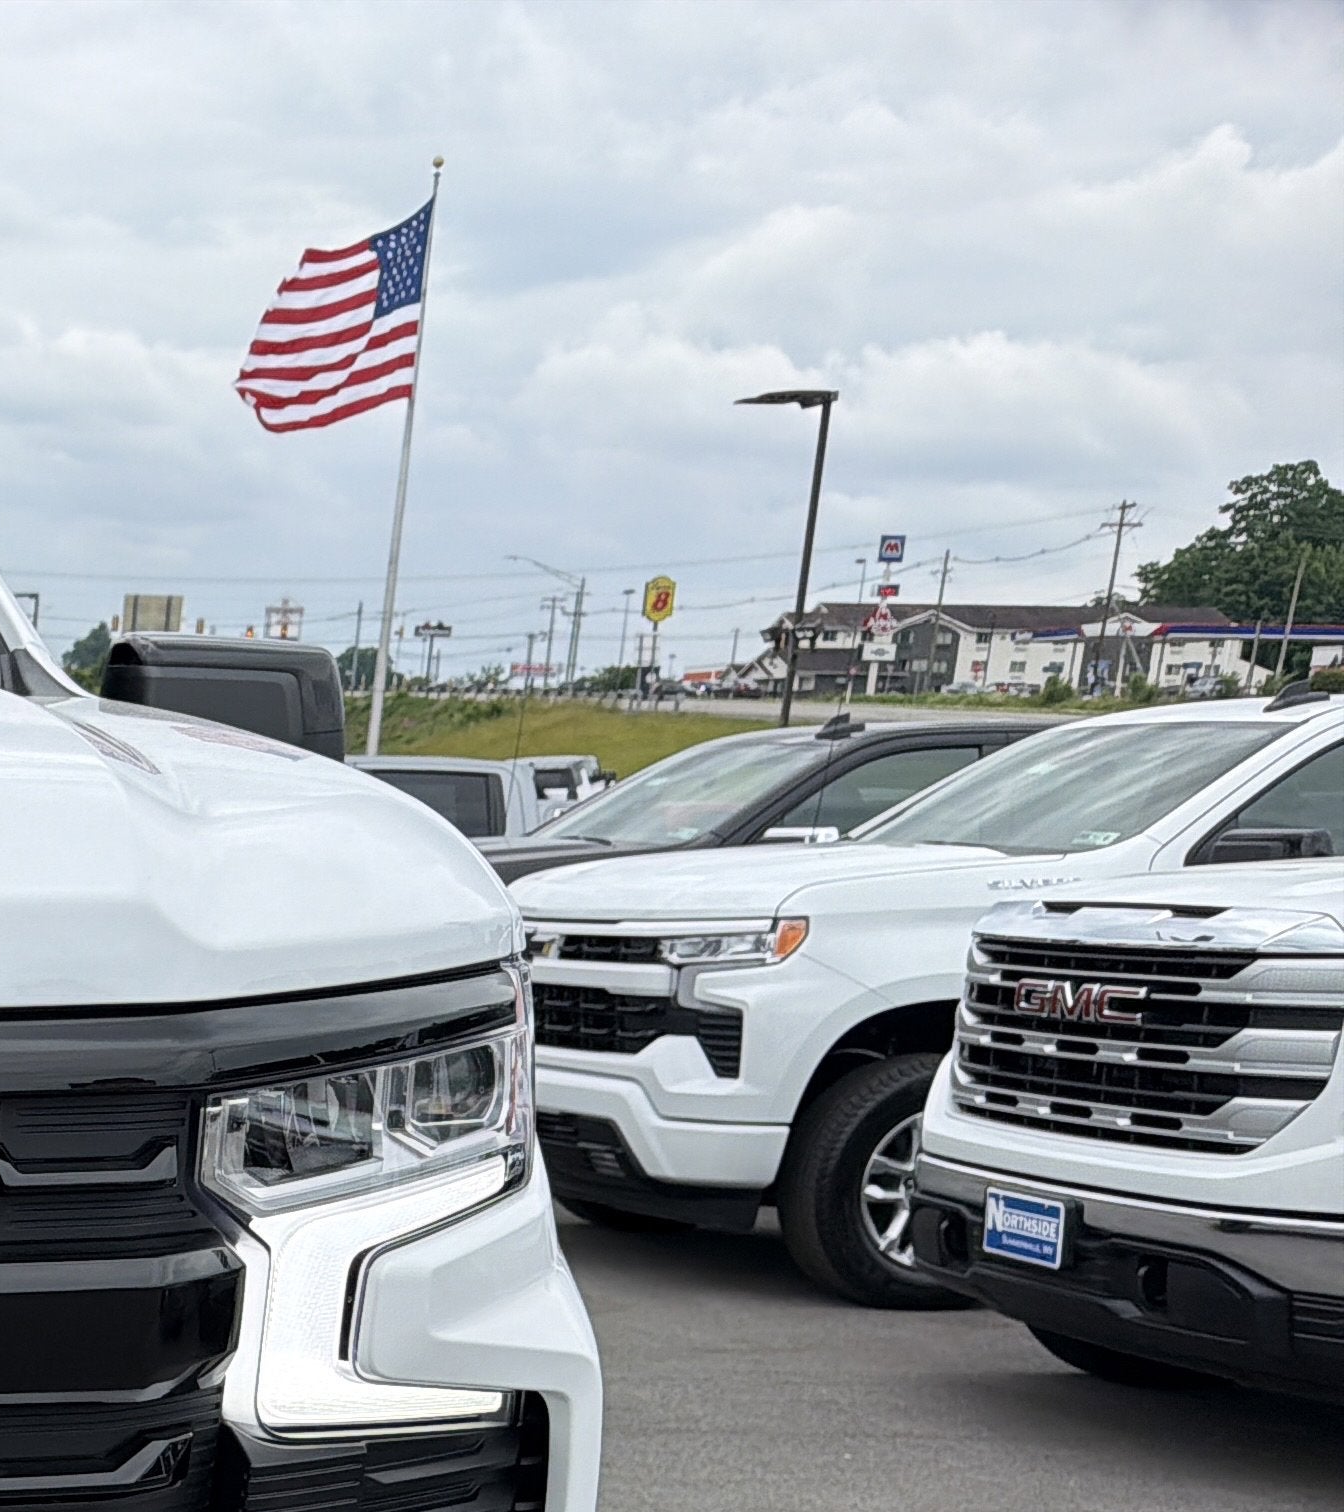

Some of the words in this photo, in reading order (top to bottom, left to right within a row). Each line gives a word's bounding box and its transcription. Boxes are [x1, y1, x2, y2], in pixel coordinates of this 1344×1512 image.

[652, 591, 670, 612] 8
[1014, 978, 1148, 1025] GMC
[987, 1196, 1058, 1238] NORTHSIDE
